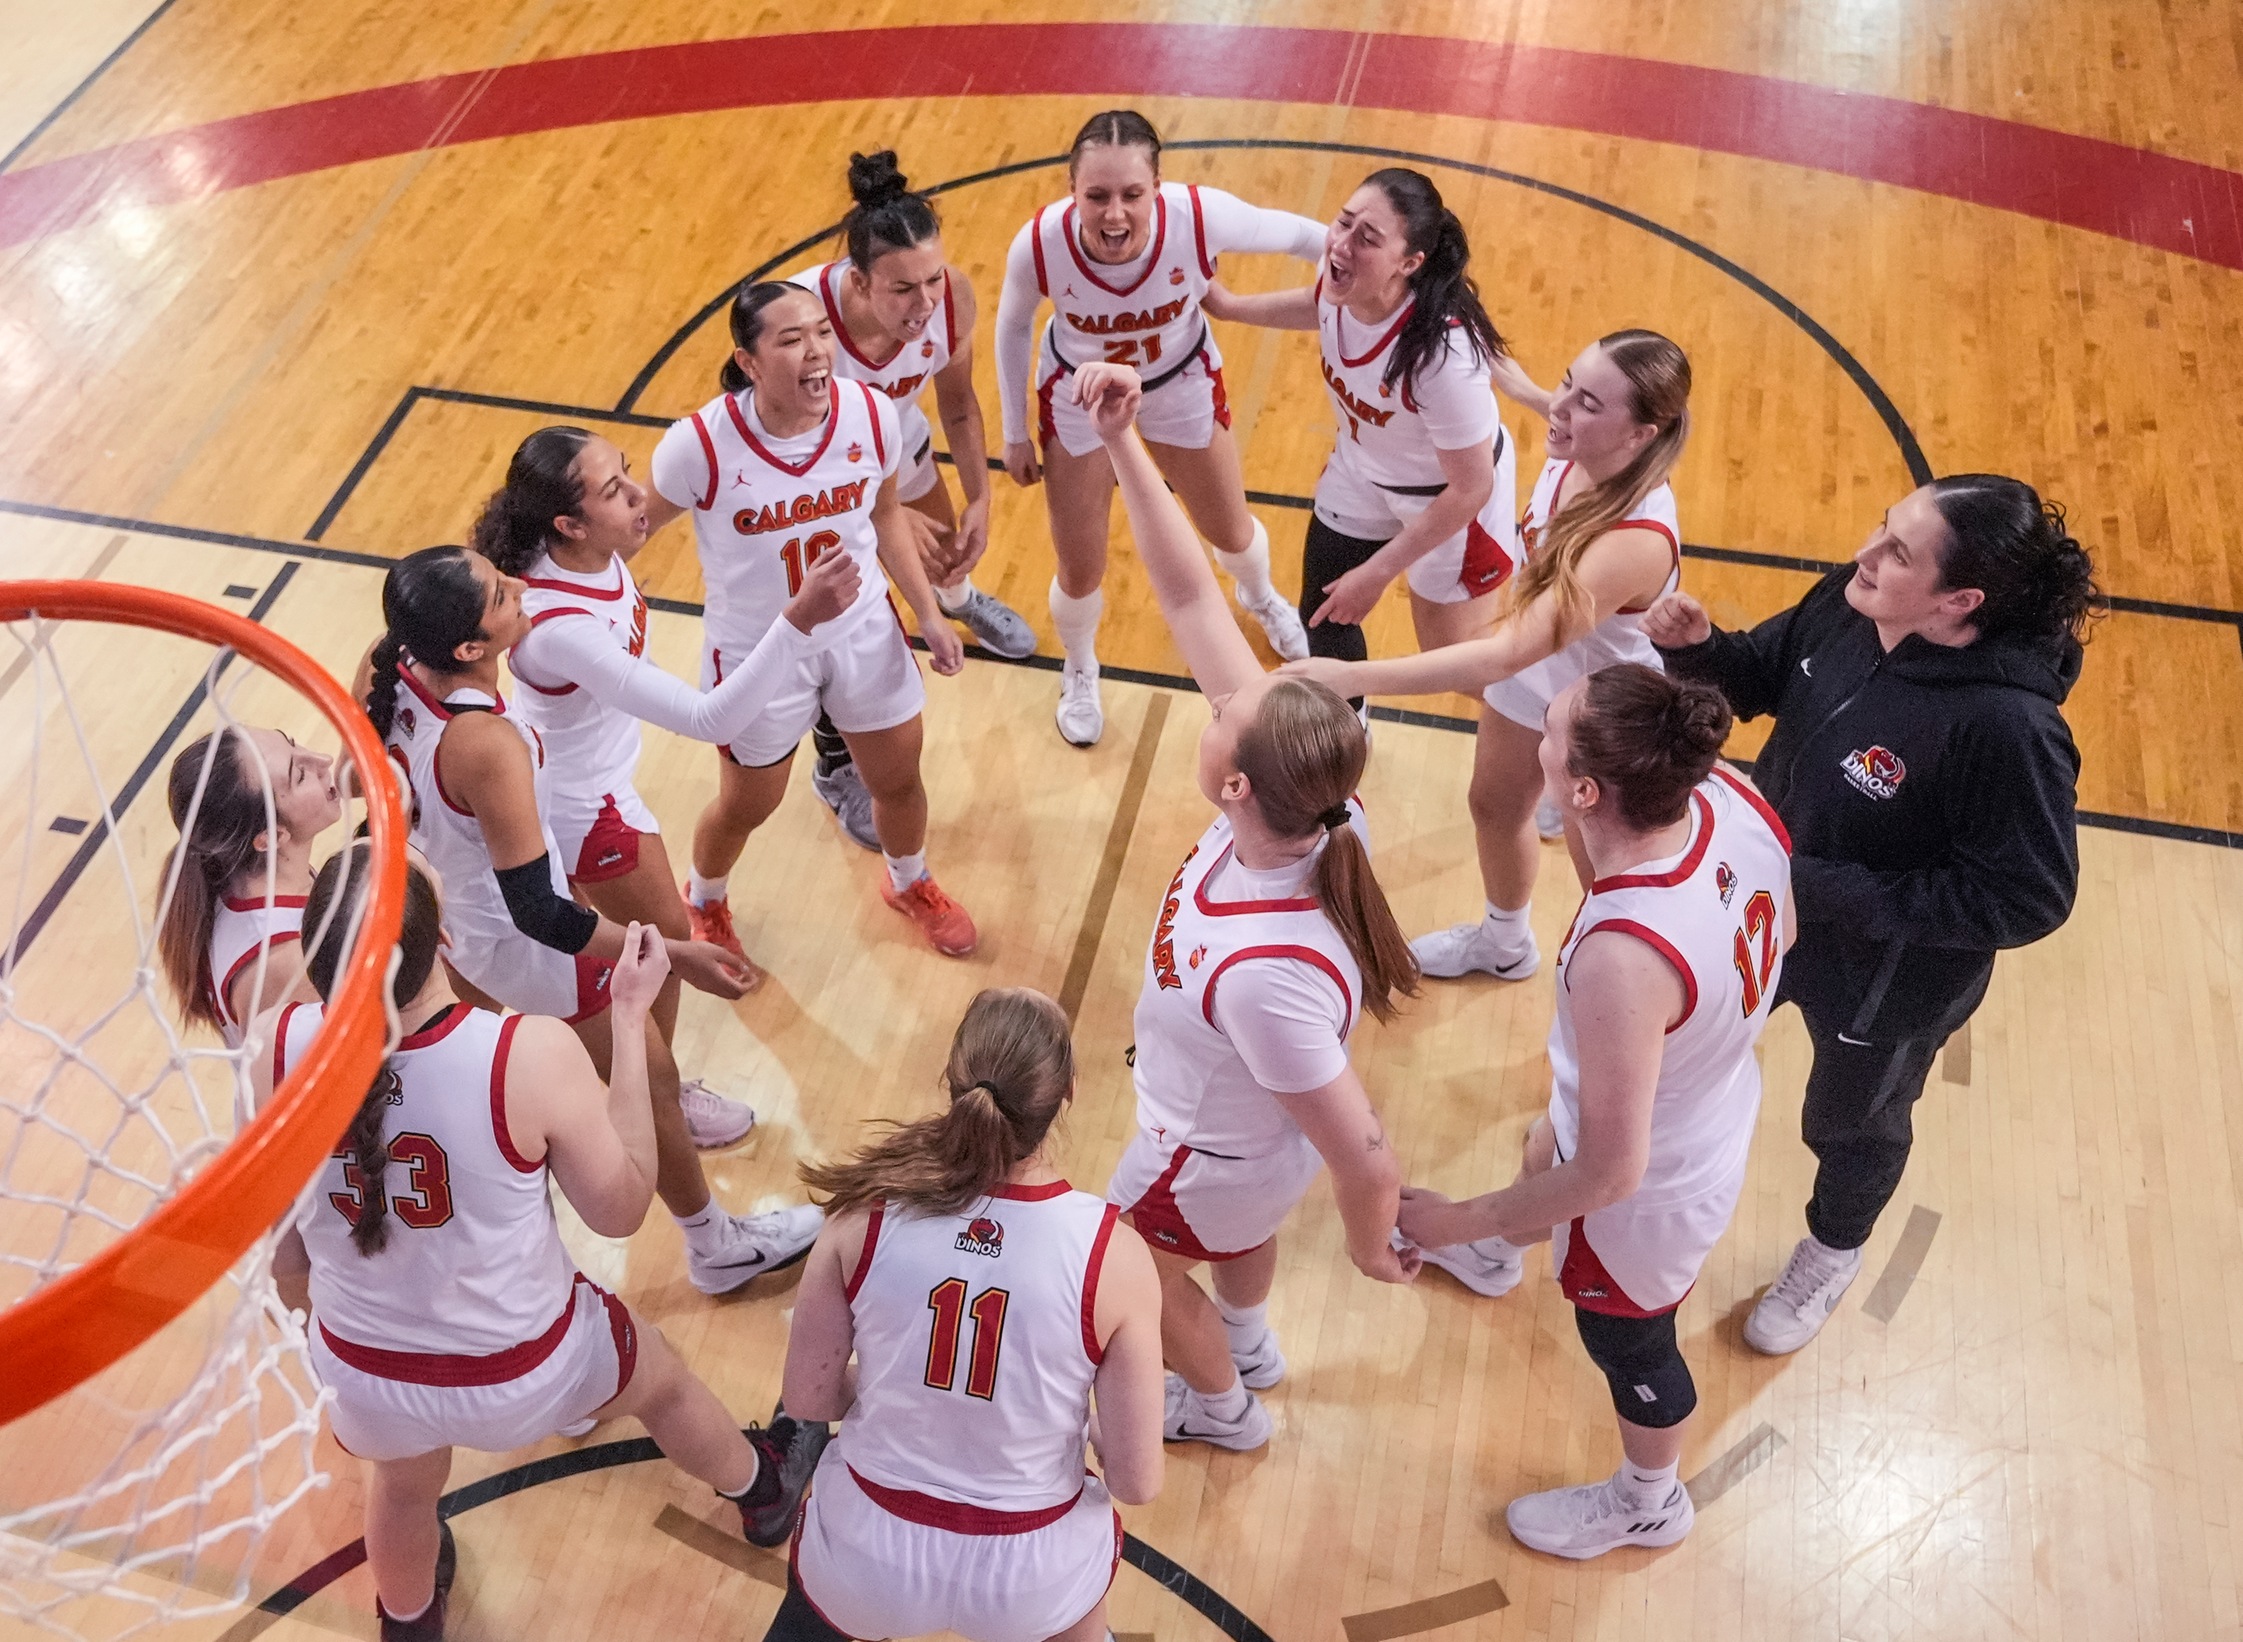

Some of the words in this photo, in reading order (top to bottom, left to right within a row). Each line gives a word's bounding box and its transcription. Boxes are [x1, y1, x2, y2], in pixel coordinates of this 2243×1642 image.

[1065, 293, 1190, 335] CALGARY
[1103, 333, 1162, 368] 21
[733, 477, 870, 536] CALGARY
[1840, 750, 1894, 799] DINOS
[1720, 873, 1738, 910] DINOS
[1734, 890, 1777, 1019] 12
[954, 1234, 1002, 1259] DINOS
[923, 1276, 1011, 1403] 11
